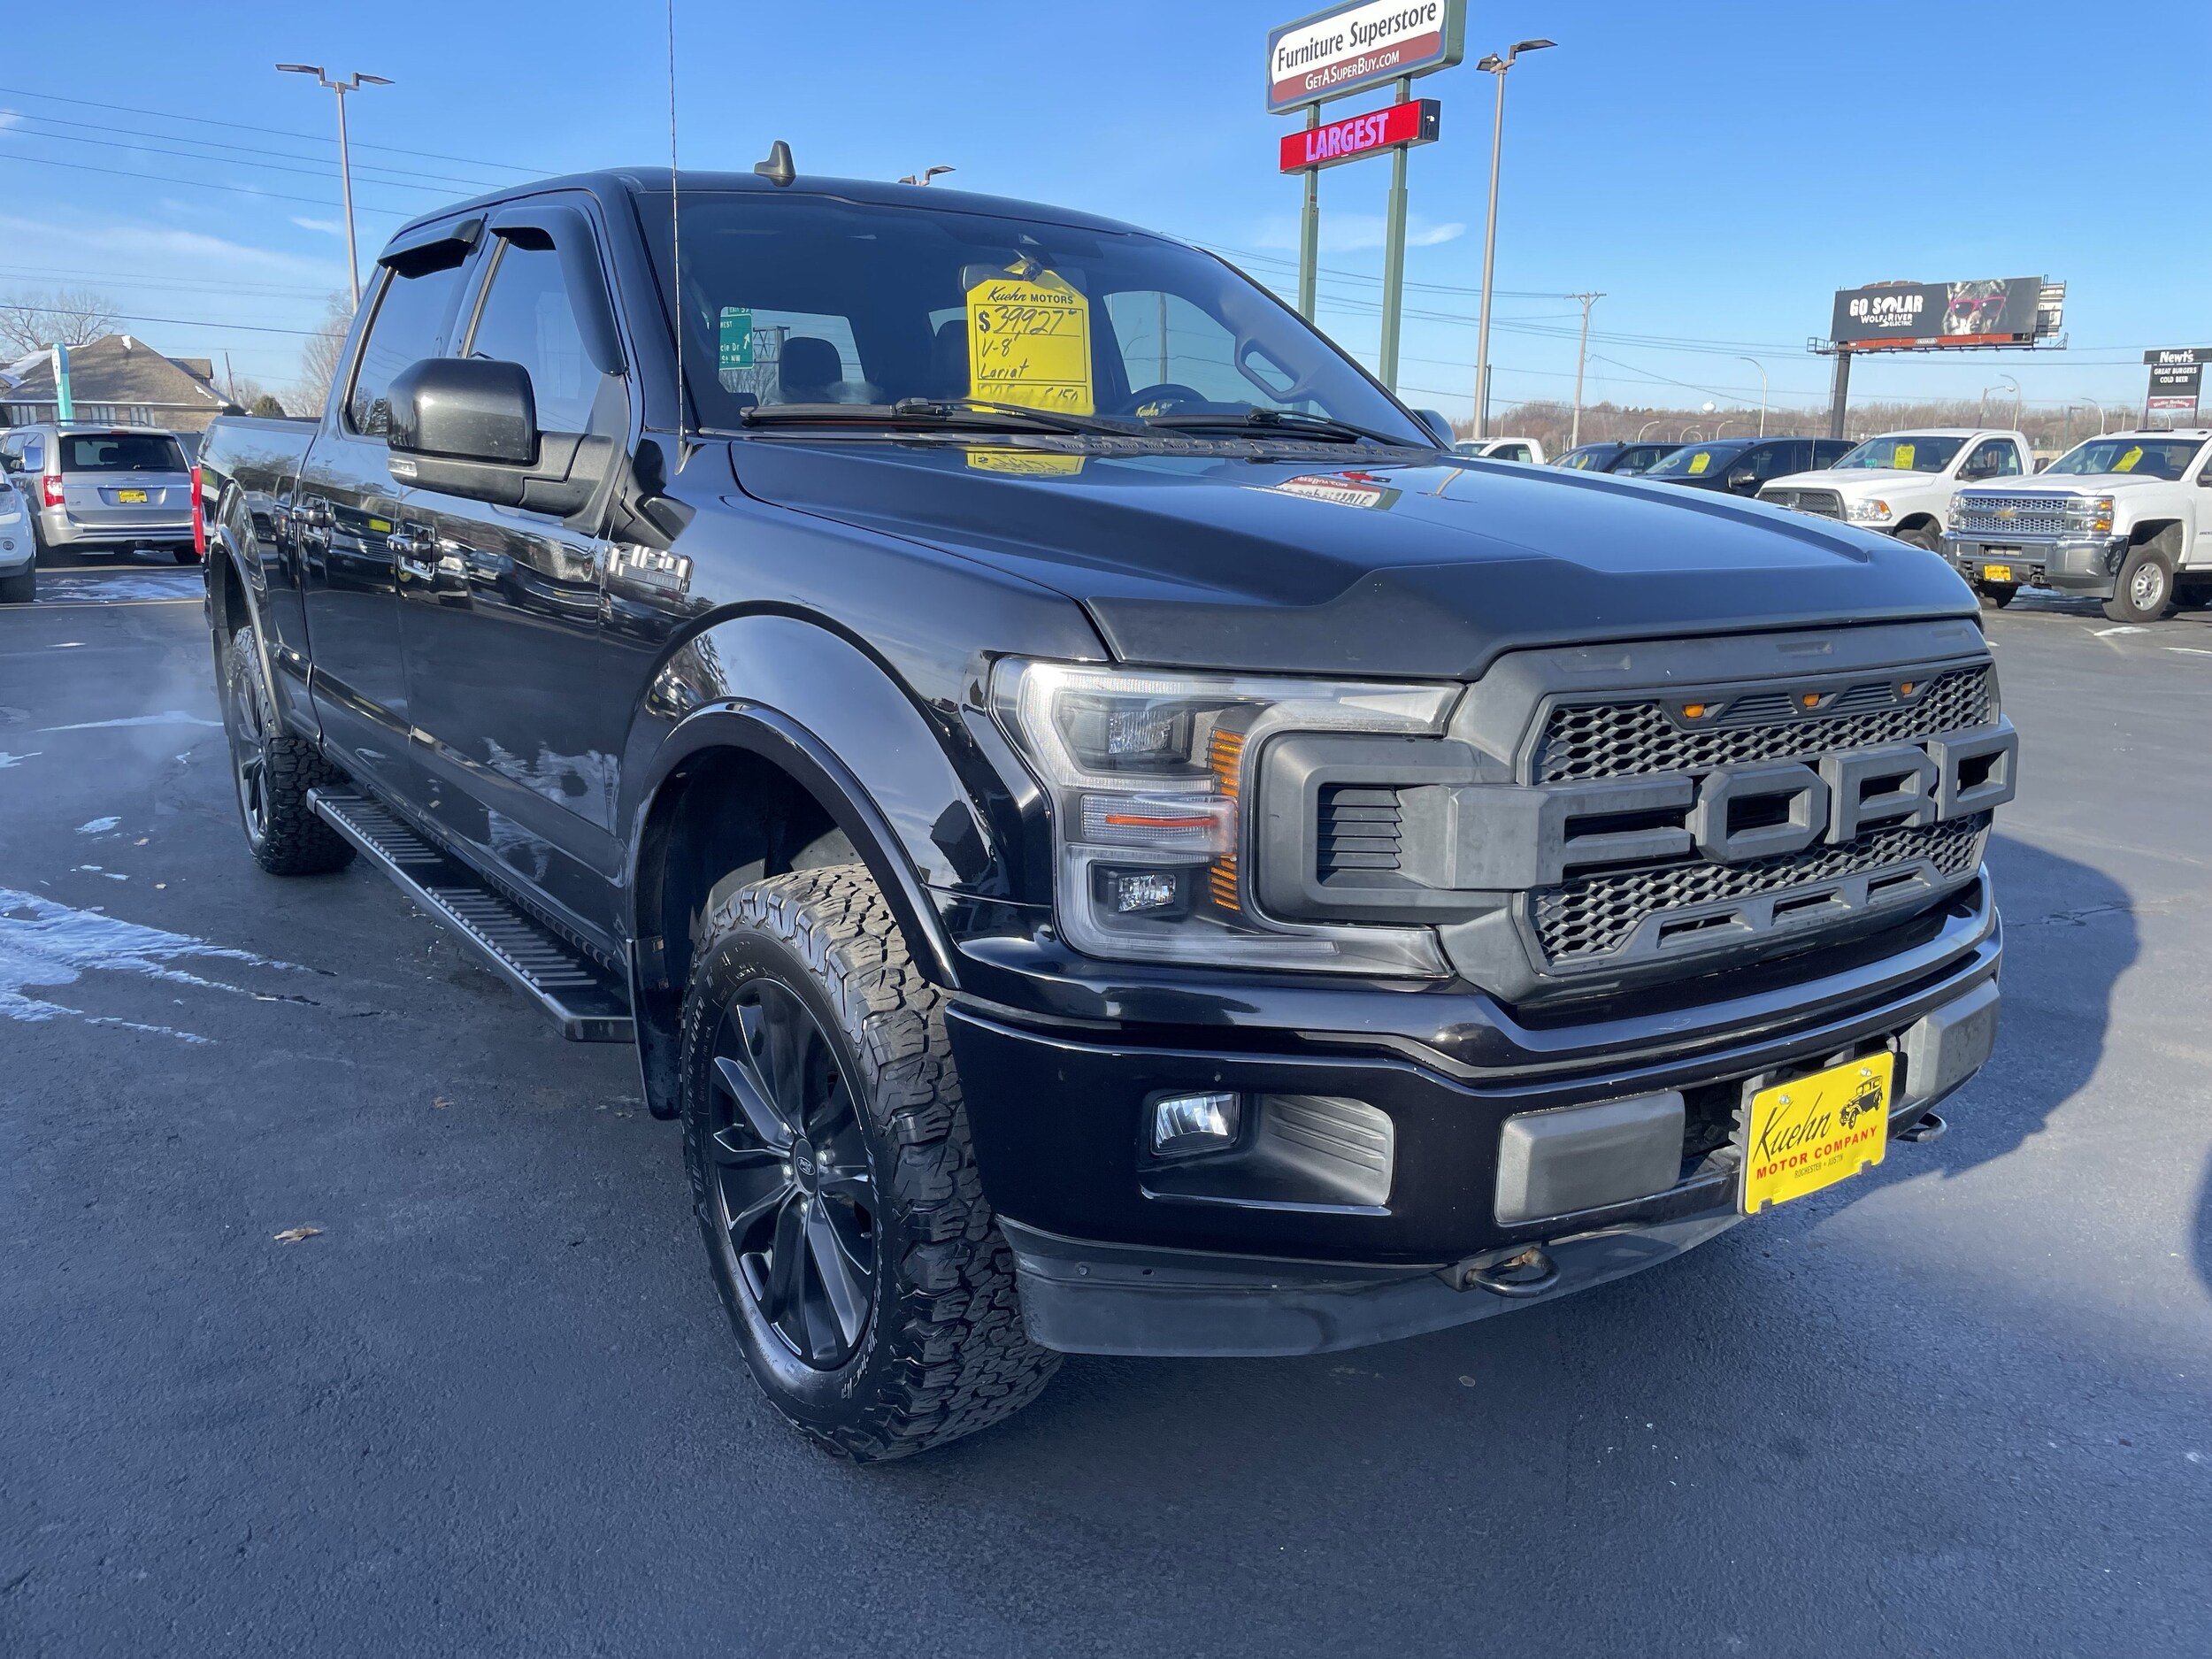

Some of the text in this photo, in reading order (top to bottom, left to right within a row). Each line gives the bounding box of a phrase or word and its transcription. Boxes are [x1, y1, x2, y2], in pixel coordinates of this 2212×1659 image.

[1278, 2, 1436, 72] Furniture Superstore
[1305, 112, 1389, 162] LARGEST
[987, 286, 1073, 304] Kuehn MOTORS
[1849, 296, 1924, 317] GO SOLAR
[1861, 313, 1913, 324] WOLF RIVER
[732, 342, 740, 351] Dr
[2159, 349, 2194, 364] Newt's
[721, 354, 741, 364] St NW
[979, 358, 1029, 380] Lariat
[2171, 366, 2197, 375] BURGERS
[1538, 722, 2019, 889] FORD
[1753, 1091, 1832, 1163] Kuehn
[1756, 1125, 1878, 1179] MOTOR COMPANY
[1794, 1153, 1844, 1179] ROCHESTER AUSTIN
